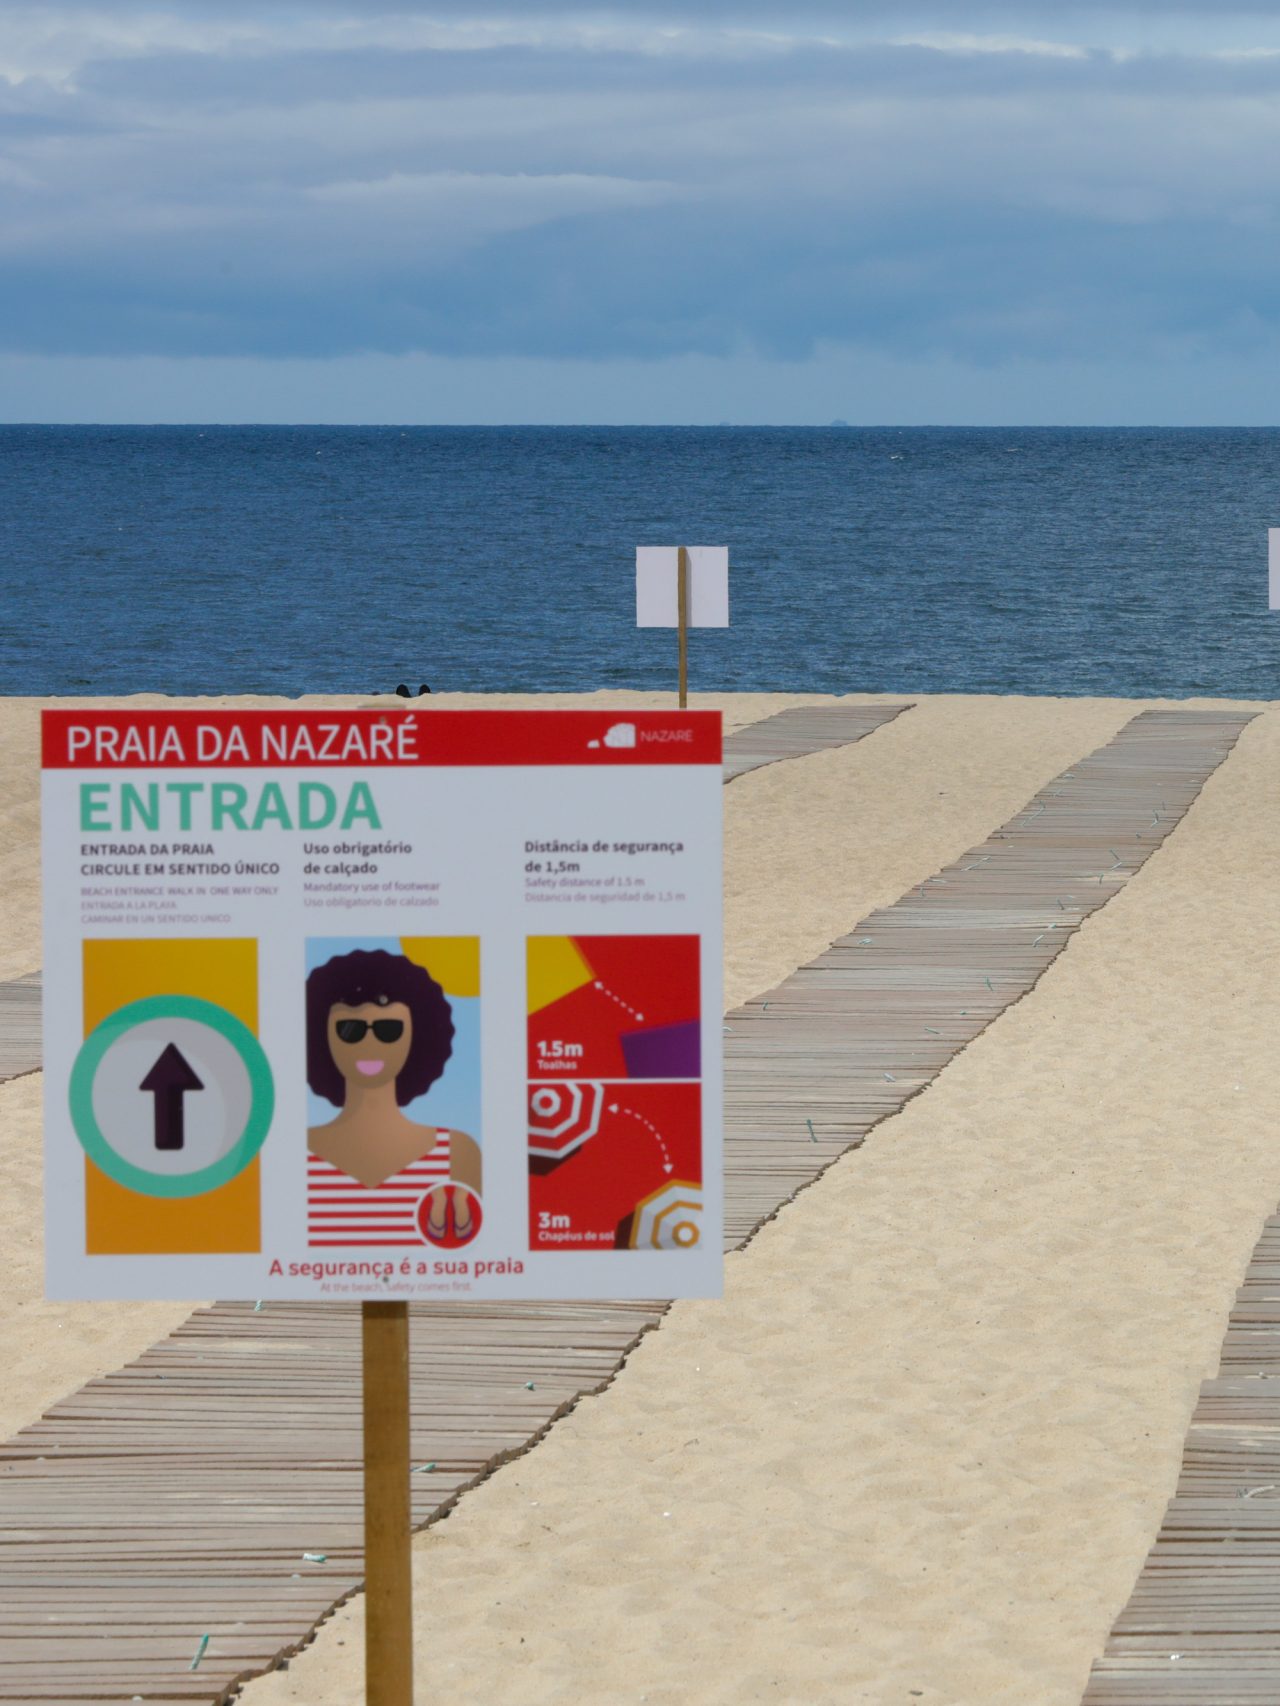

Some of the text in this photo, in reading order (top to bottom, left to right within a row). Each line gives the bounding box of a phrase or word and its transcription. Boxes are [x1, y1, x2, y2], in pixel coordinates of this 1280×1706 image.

[66, 714, 420, 762] PRAIA DA NAZARÉ
[79, 780, 382, 832] ENTRADA
[80, 843, 215, 856] ENTRADA DA PRAIA
[303, 840, 413, 857] Uso obrigatório
[525, 839, 685, 856] Distância de segurança
[80, 859, 280, 876] CIRCULE EM SENTIDO ÚNICO
[303, 862, 378, 877] de calçado
[525, 861, 580, 874] de 1,5m
[303, 881, 440, 893] Mandatory use of footwear
[525, 877, 557, 889] Safety
[559, 877, 600, 888] distance
[604, 877, 615, 887] of
[634, 878, 645, 887] m
[536, 1040, 583, 1057] 1.5m
[537, 1059, 577, 1070] Toalhas
[538, 1212, 571, 1229] 3m
[538, 1229, 615, 1243] Chapéus de sol
[269, 1257, 524, 1279] A segurança é a sua praia
